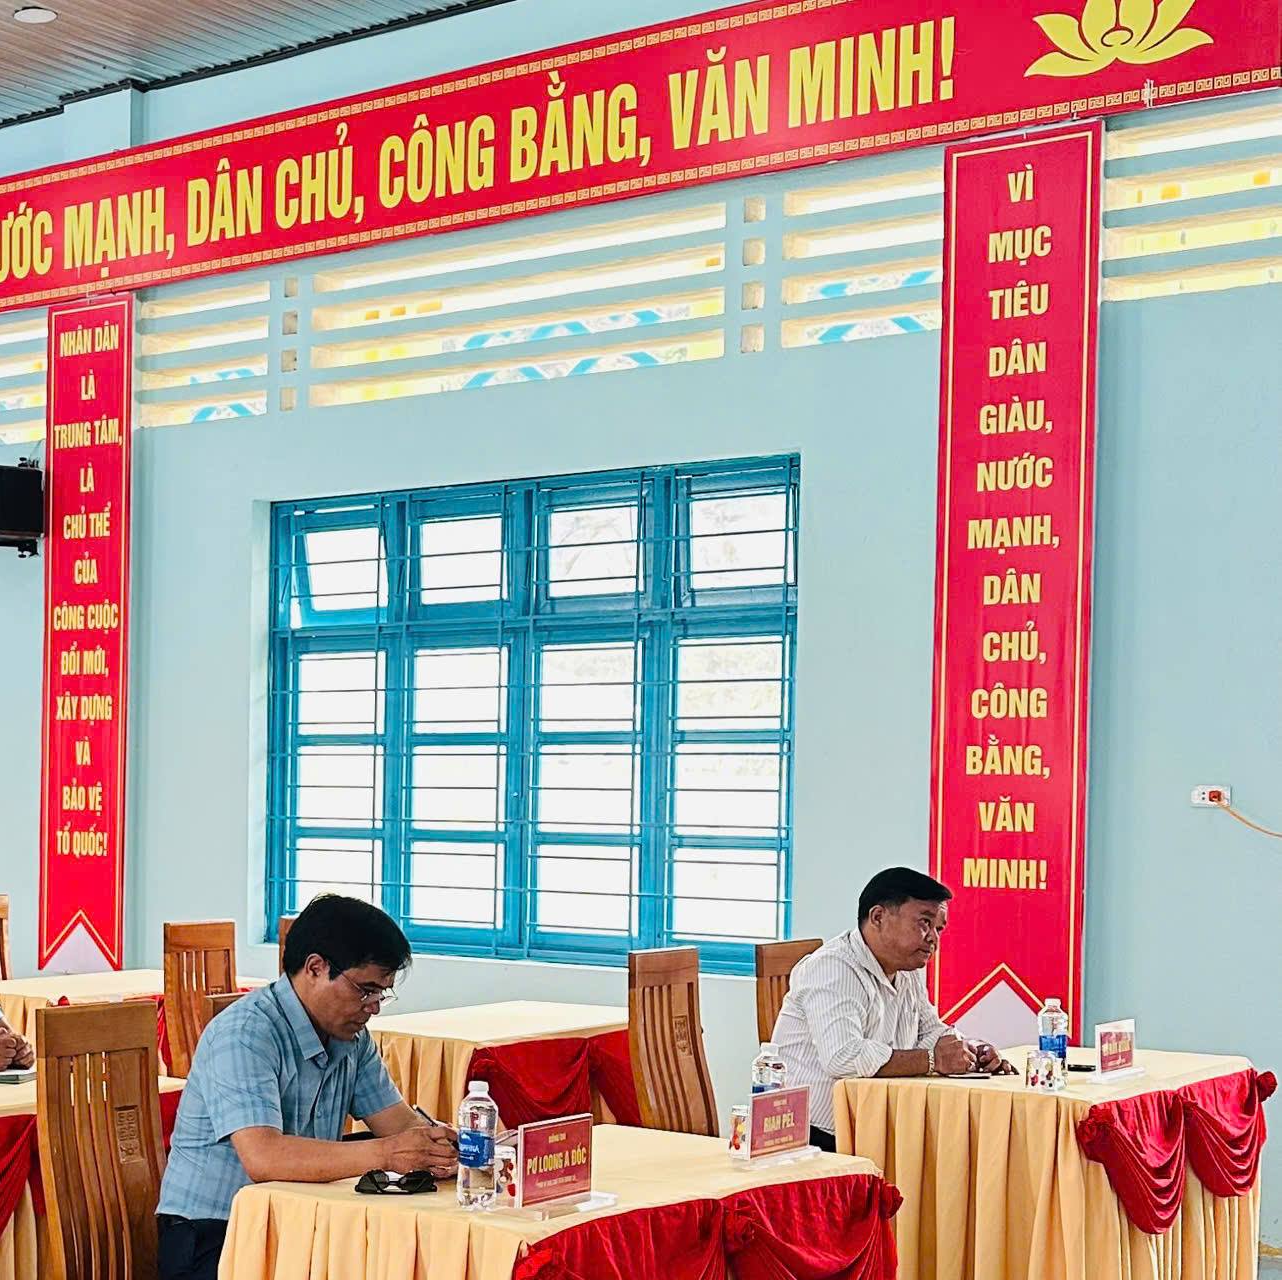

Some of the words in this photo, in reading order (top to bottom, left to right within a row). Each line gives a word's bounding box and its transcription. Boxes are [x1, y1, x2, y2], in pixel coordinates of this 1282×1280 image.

[64, 187, 175, 279] MẠNH,
[188, 158, 263, 246] DÂN
[276, 122, 364, 228] CHỦ,
[380, 115, 495, 208] CÔNG
[510, 72, 651, 182] BẰNG,
[669, 47, 770, 149] VĂN
[788, 17, 955, 128] MINH!
[1007, 163, 1034, 202] VÌ
[988, 225, 1052, 266] MỤC
[988, 279, 1049, 320] TIÊU
[60, 324, 92, 357] NHÂN
[95, 320, 119, 352] DÂN
[988, 338, 1047, 377] DÂN
[80, 369, 96, 401] LÀ
[54, 421, 91, 449] TRUNG
[94, 414, 123, 446] TÂM,
[979, 395, 1053, 435] GIÀU,
[79, 461, 95, 493] LÀ
[976, 451, 1053, 493] NƯỚC
[63, 505, 86, 539] CHỦ
[90, 501, 111, 537] THỂ
[967, 514, 1060, 555] MẠNH,
[74, 551, 98, 585] CỦA
[983, 567, 1041, 606] DÂN
[53, 600, 85, 631] CÔNG
[87, 598, 118, 635] CUỘC
[61, 640, 80, 676] ĐỔI
[83, 645, 109, 677] MỚI,
[982, 620, 1047, 664] CHỦ,
[56, 691, 78, 720] XÂY
[80, 693, 112, 726] DỰNG
[971, 682, 1048, 720] CÔNG
[75, 736, 91, 766] VÀ
[965, 734, 1051, 780] BẰNG,
[62, 777, 85, 811] BẢO
[88, 781, 103, 816] VỆ
[978, 795, 1035, 833] VĂN
[56, 821, 71, 855] TỔ
[72, 823, 108, 858] QUỐC!
[963, 857, 1047, 890] MINH!
